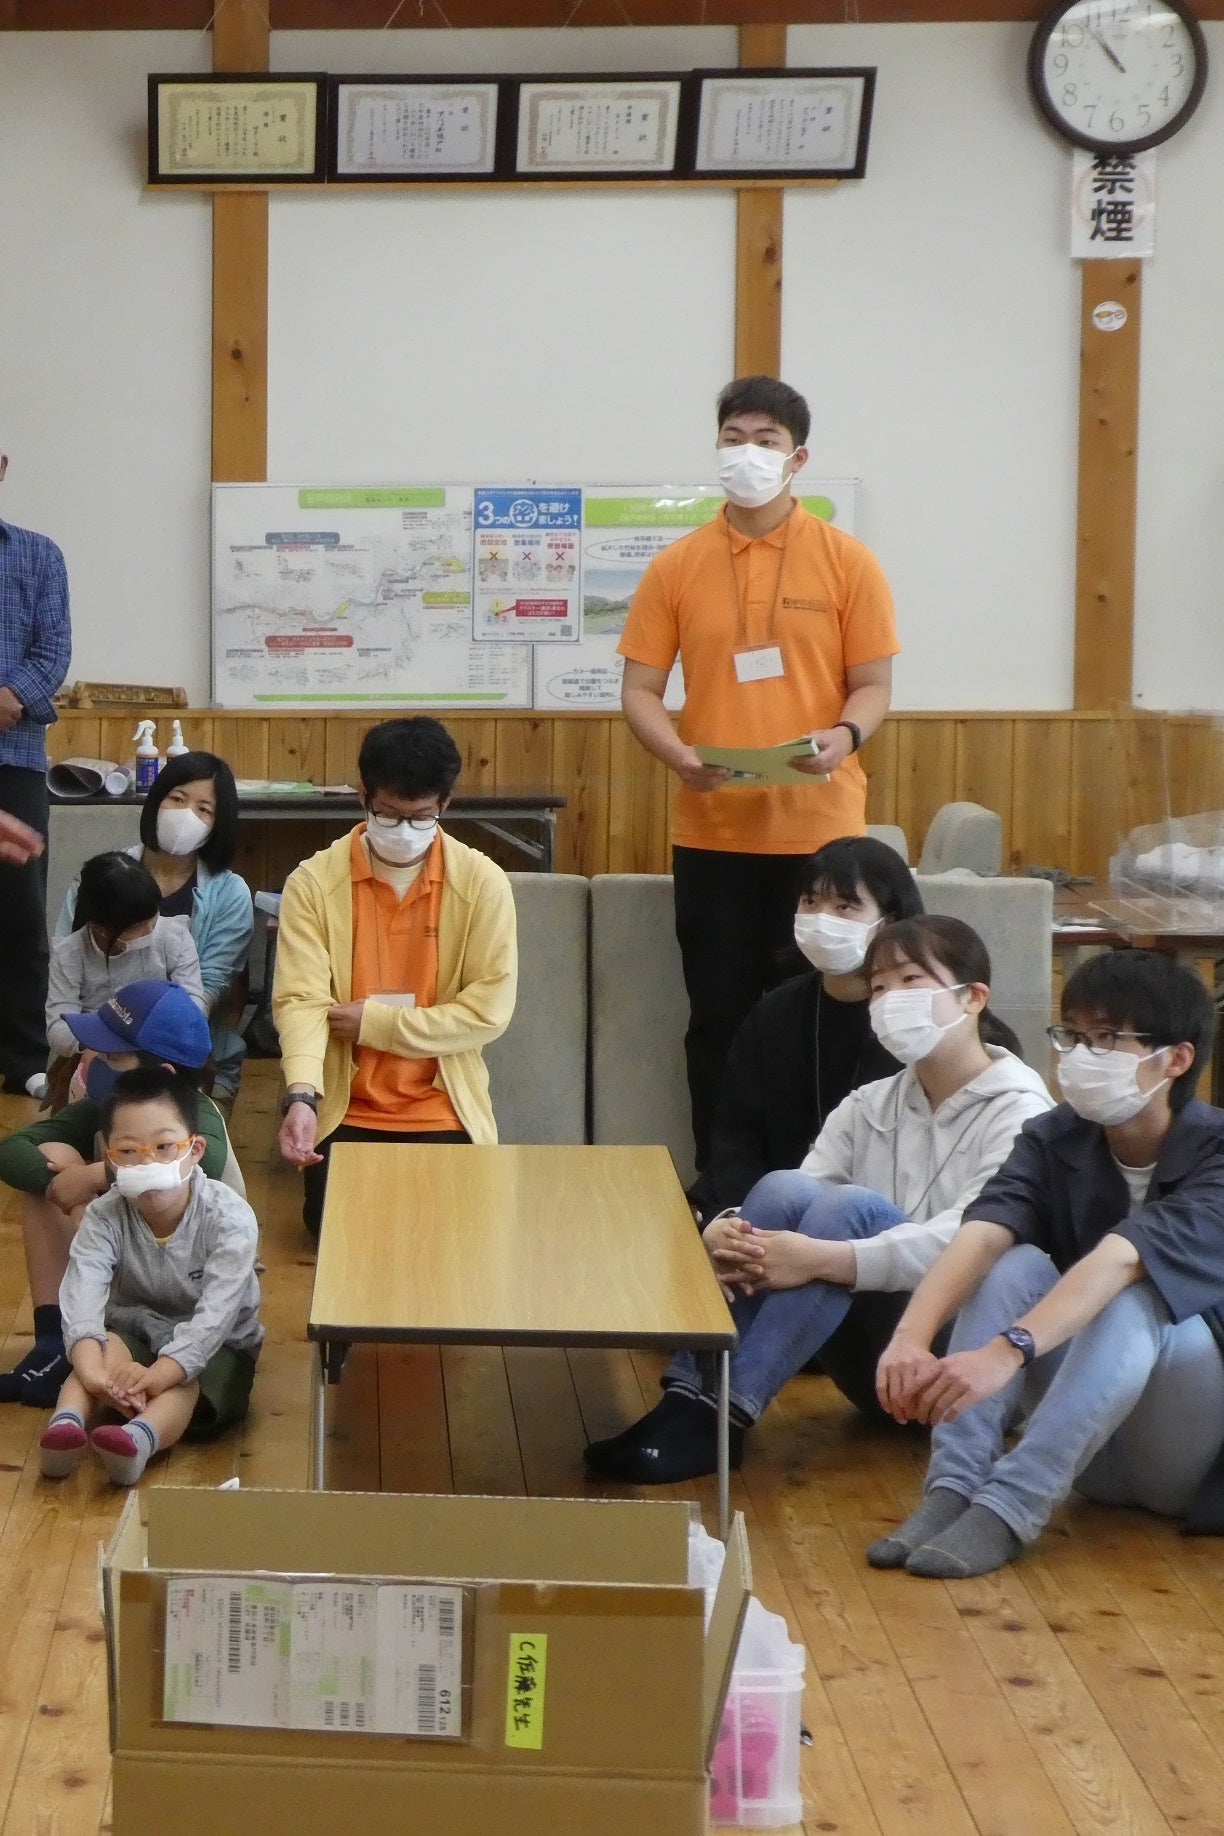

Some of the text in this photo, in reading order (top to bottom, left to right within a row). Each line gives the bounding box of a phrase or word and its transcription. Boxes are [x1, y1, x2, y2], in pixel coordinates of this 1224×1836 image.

[1061, 23, 1085, 48] 10
[1161, 25, 1174, 48] 2
[1054, 54, 1069, 77] 9
[1172, 55, 1184, 78] 3
[1062, 83, 1078, 107] 8
[1157, 85, 1170, 107] 4
[1083, 105, 1098, 128] 7
[1109, 109, 1125, 132] 6
[1137, 104, 1151, 127] 5
[1090, 153, 1136, 242] 禁煙
[439, 1689, 451, 1715] 612
